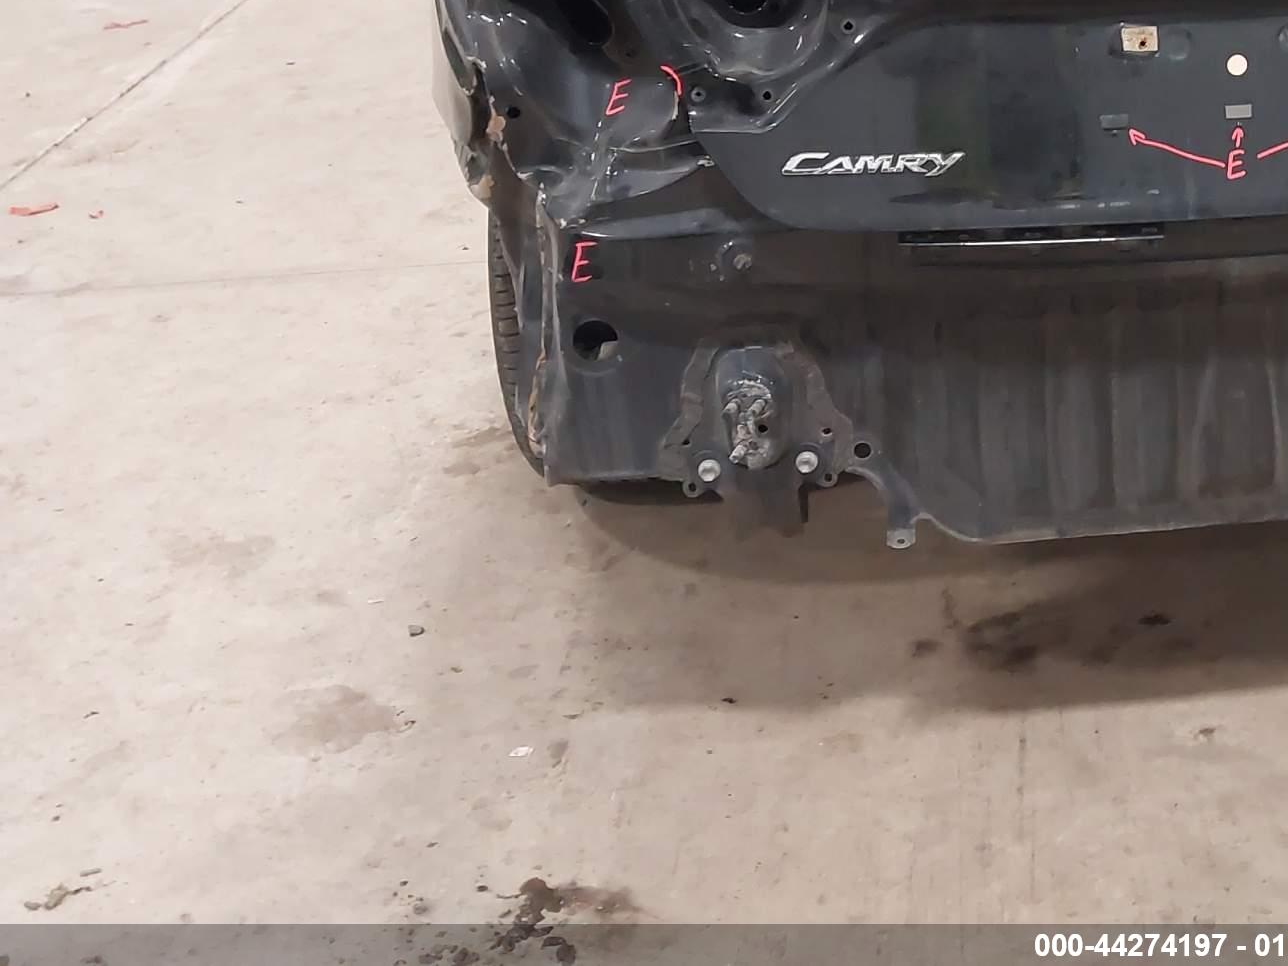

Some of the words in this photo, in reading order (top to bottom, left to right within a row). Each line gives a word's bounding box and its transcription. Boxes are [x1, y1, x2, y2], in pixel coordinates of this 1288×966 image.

[605, 78, 632, 116] E
[781, 151, 966, 177] CAMRY
[1227, 149, 1246, 180] E
[571, 241, 598, 282] E
